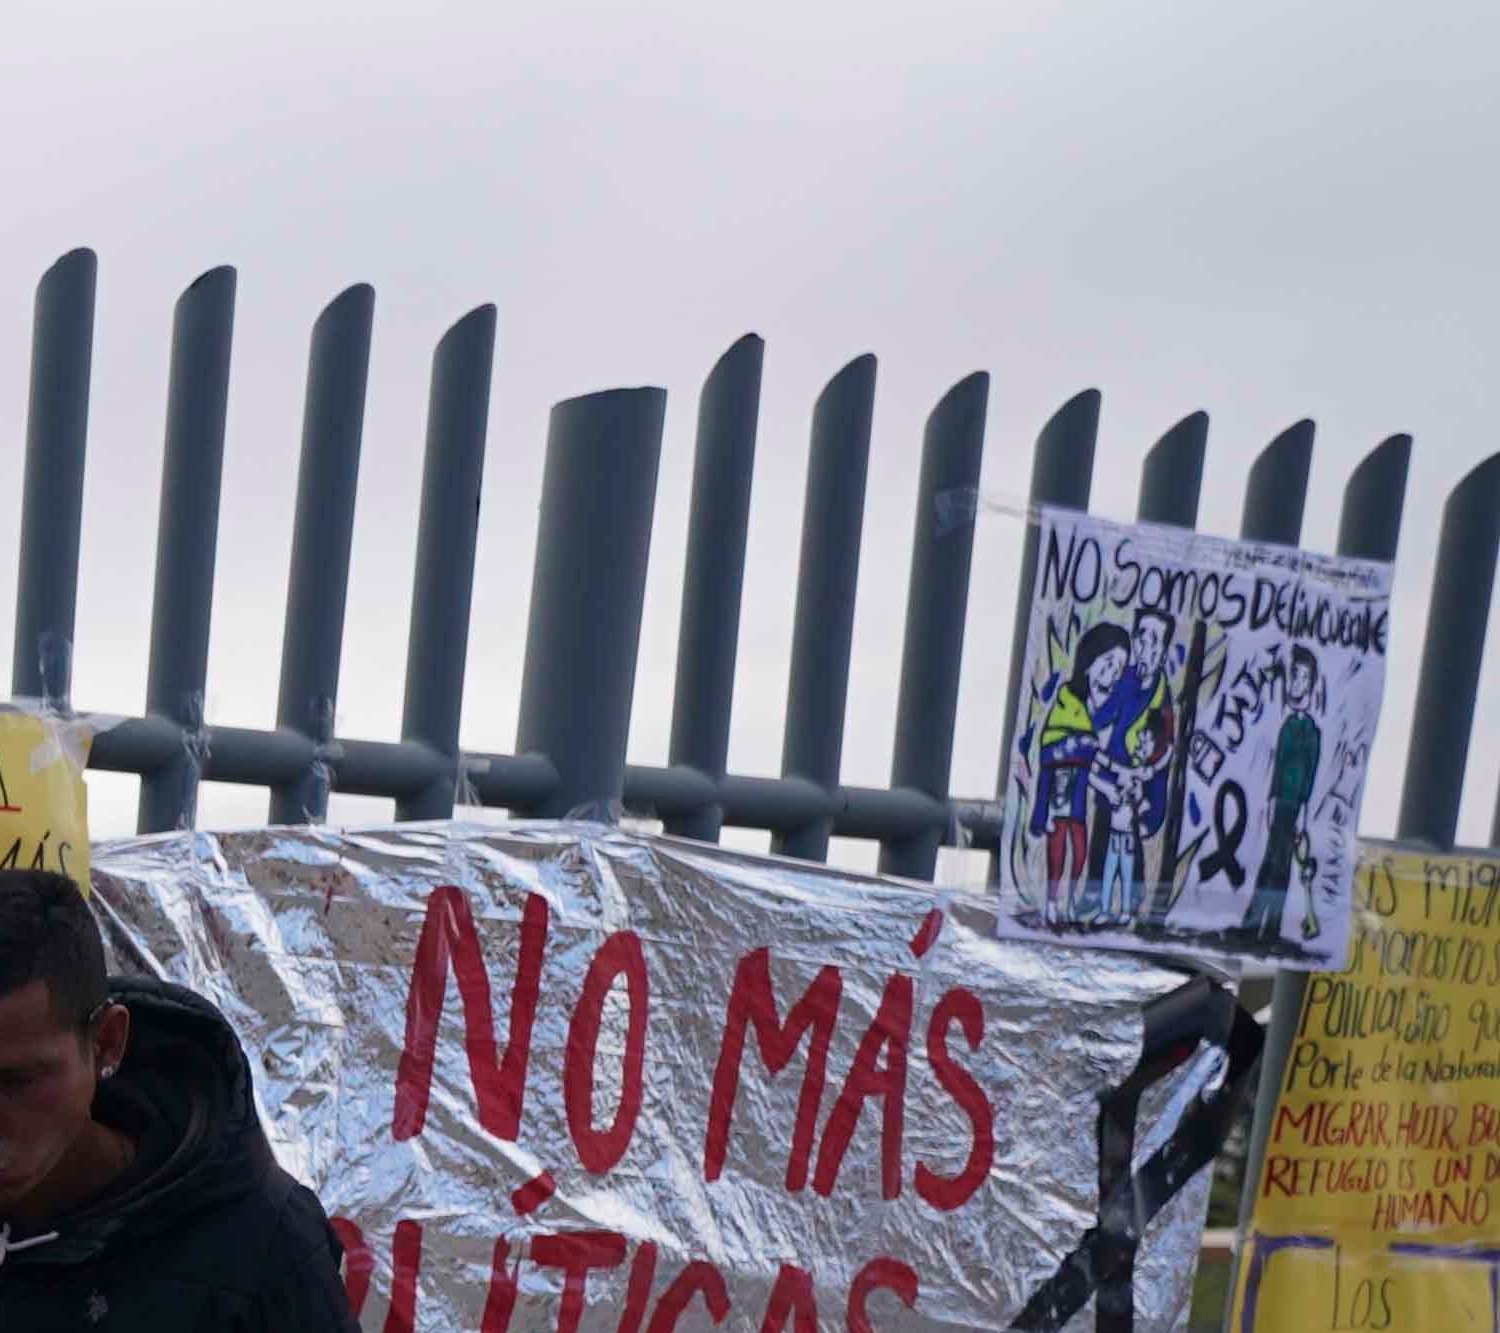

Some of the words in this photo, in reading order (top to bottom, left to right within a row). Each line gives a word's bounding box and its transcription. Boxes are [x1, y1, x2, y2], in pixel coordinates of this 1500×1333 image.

[1041, 524, 1102, 605] NO
[392, 884, 650, 1176] NO
[704, 908, 997, 1213] MÁS
[1433, 1153, 1471, 1188] UN
[1371, 1190, 1491, 1233] HUMANO
